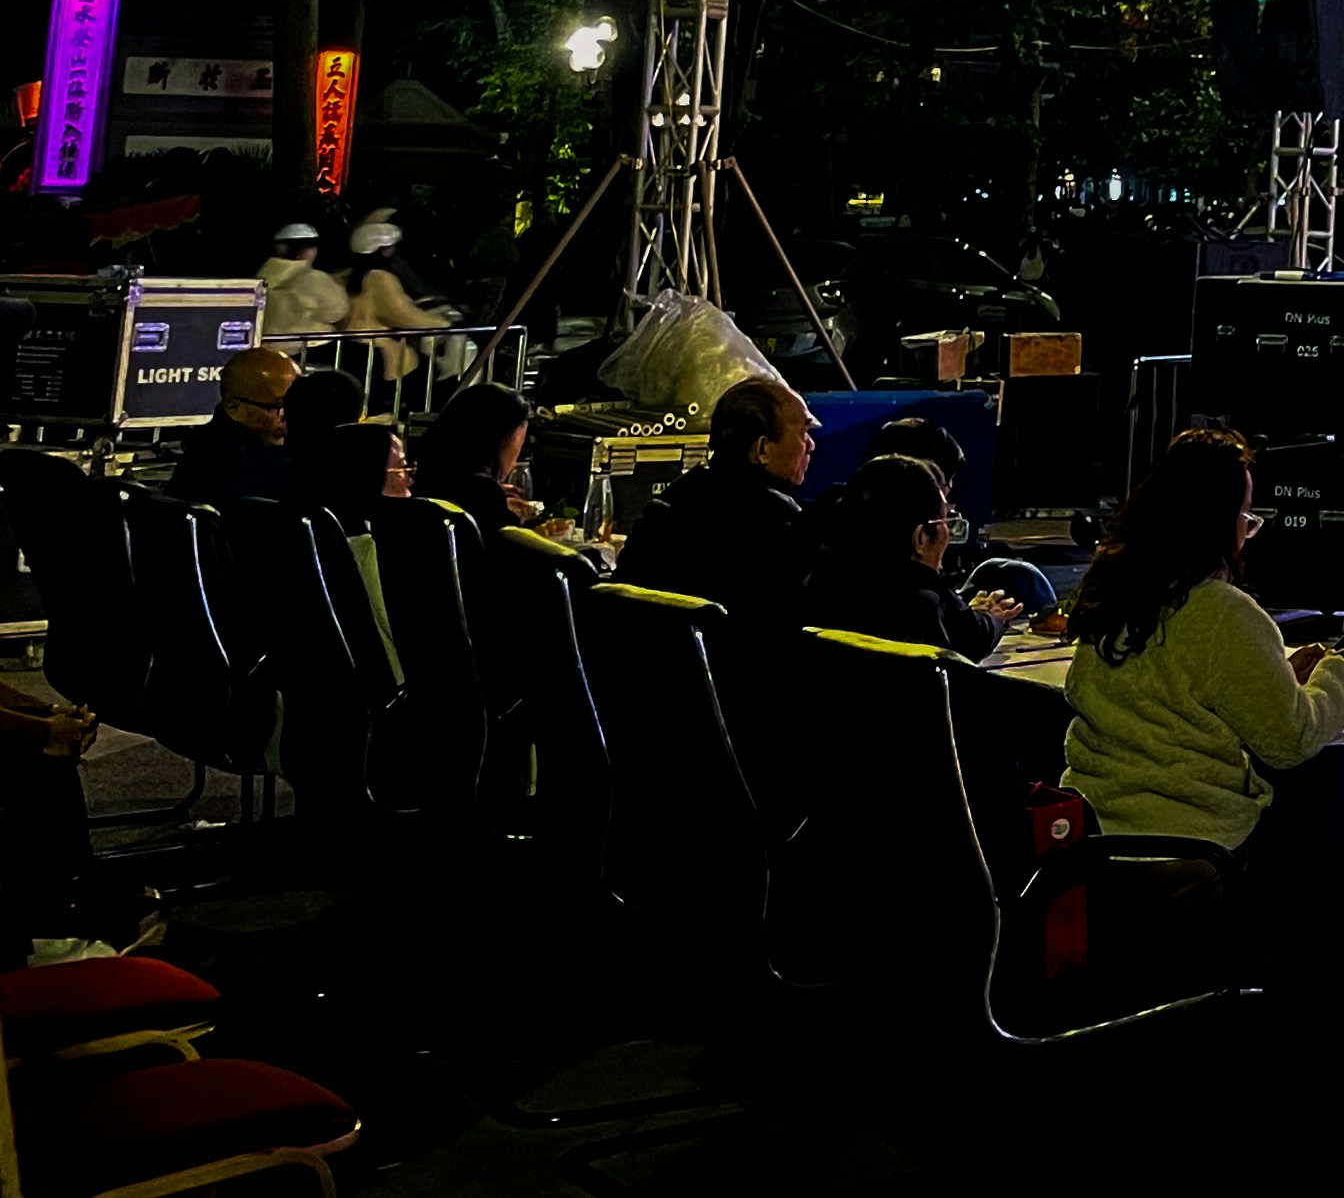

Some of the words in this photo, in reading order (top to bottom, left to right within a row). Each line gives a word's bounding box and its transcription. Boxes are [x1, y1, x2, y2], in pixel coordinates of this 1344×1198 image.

[1284, 312, 1303, 324] DN
[1306, 313, 1331, 326] Plus
[136, 366, 194, 385] LIGHT
[197, 365, 224, 382] SK
[1273, 485, 1293, 498] DN
[1296, 486, 1322, 500] Plus
[1283, 515, 1307, 529] 019
